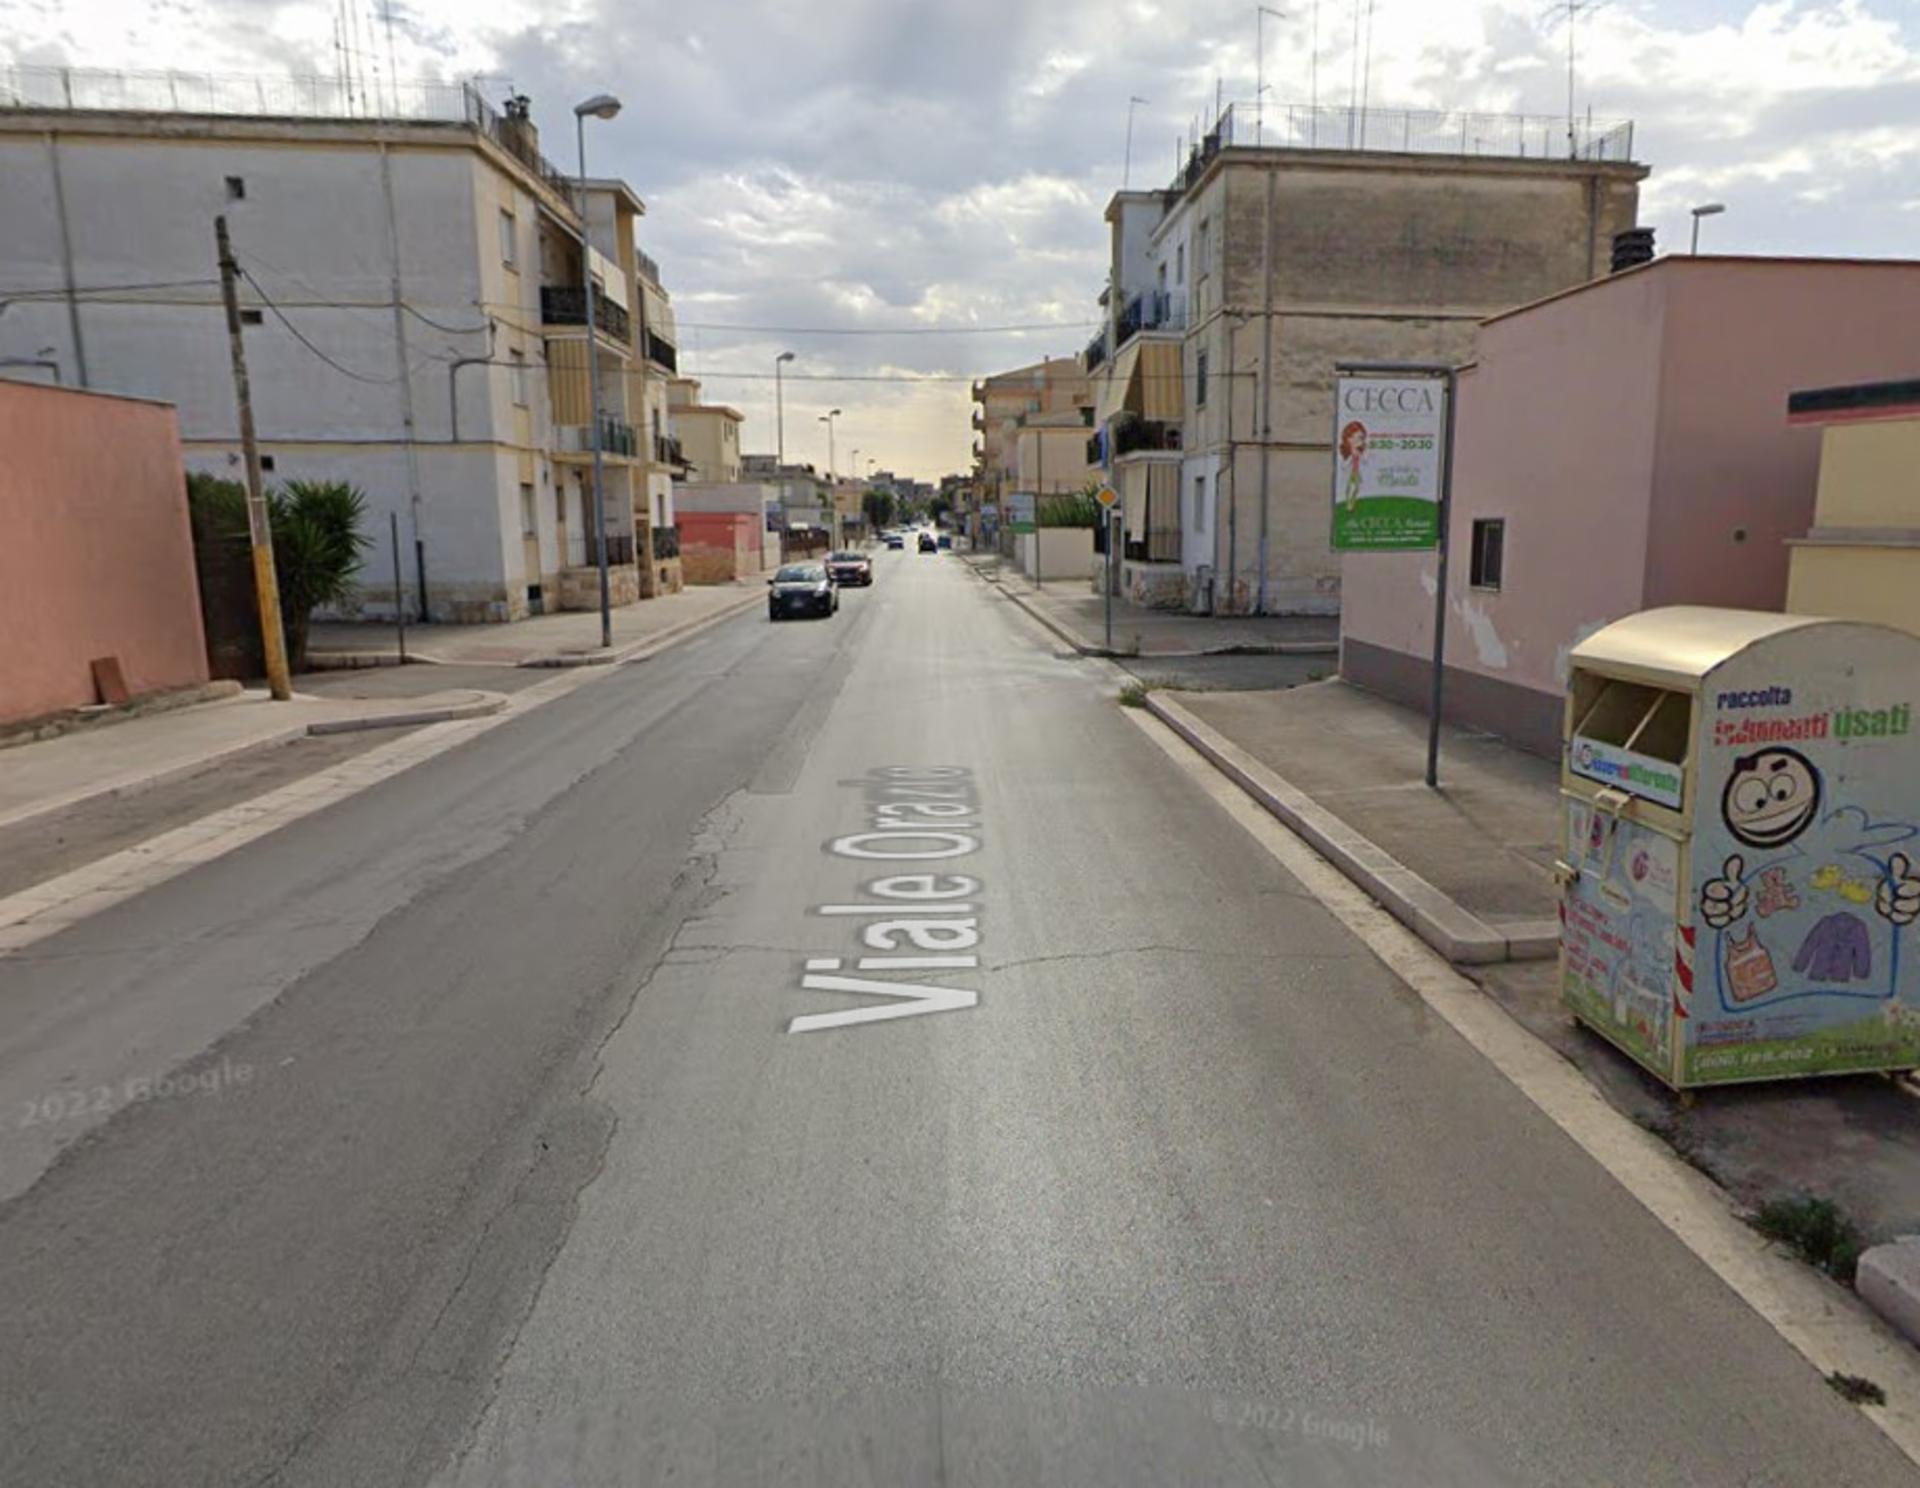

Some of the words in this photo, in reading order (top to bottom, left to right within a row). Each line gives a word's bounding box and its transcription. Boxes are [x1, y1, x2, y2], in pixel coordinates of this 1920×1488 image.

[1345, 386, 1434, 413] CECCA
[1717, 686, 1792, 710] raccolta
[1833, 702, 1912, 739] usati
